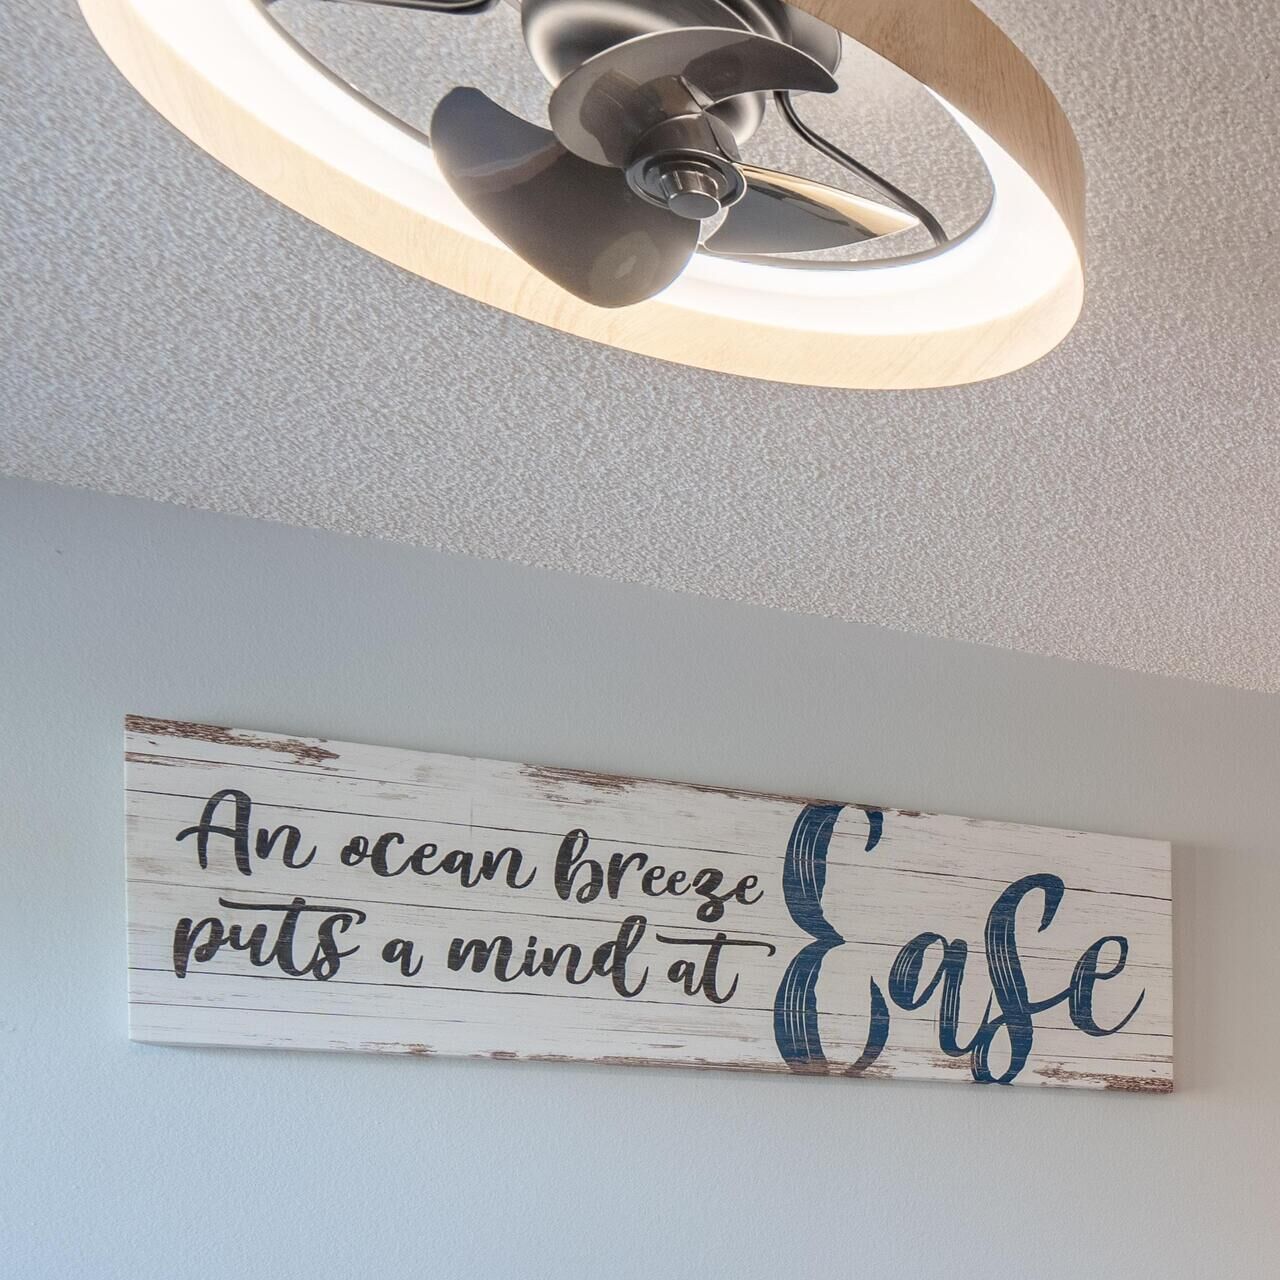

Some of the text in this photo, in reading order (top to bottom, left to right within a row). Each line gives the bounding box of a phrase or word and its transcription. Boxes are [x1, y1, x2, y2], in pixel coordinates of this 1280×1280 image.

[176, 789, 763, 923] An ocean breeze
[173, 897, 776, 1005] puts a mind at
[773, 804, 1146, 1086] Ease
